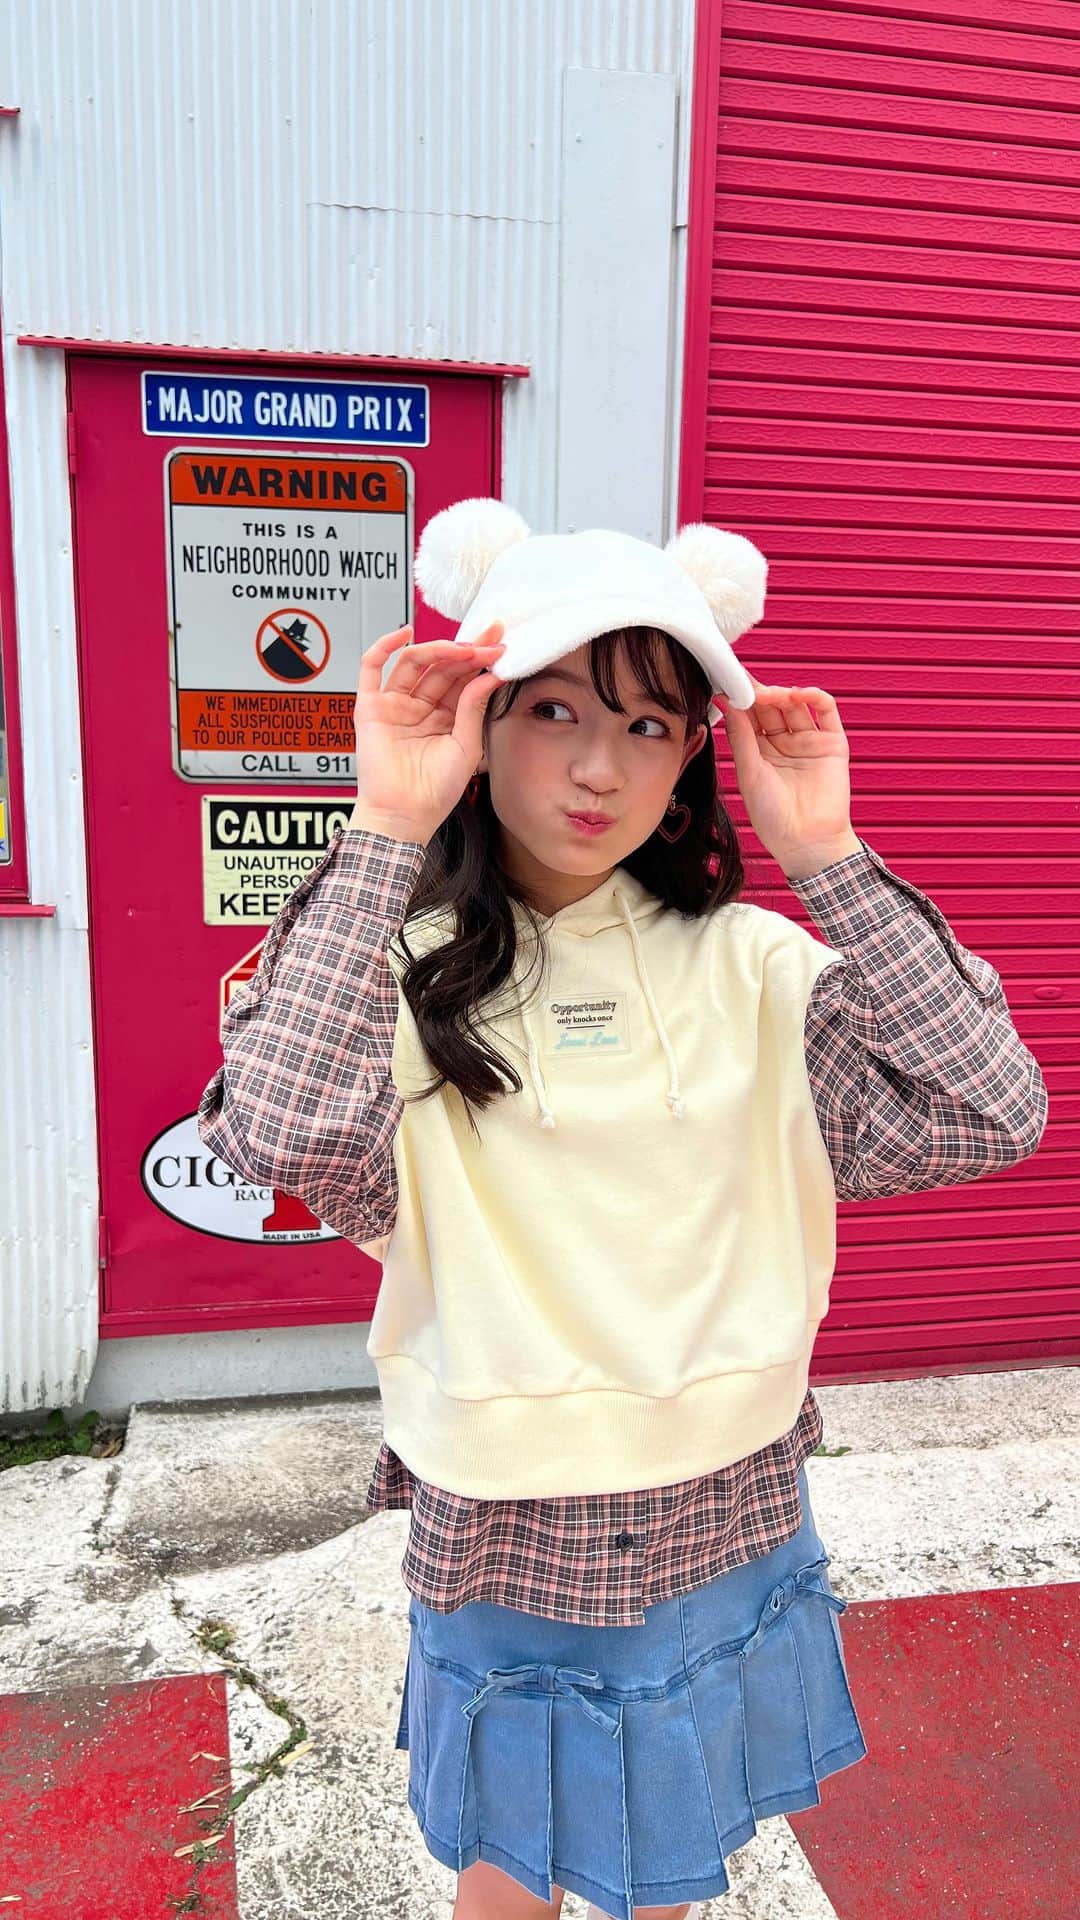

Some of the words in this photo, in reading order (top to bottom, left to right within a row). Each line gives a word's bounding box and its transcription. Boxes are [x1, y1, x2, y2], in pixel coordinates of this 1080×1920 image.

[158, 386, 243, 424] MAJOR
[254, 391, 337, 429] GRAND
[347, 395, 413, 432] PRIX
[191, 465, 387, 502] WARNING
[242, 522, 286, 538] THIS
[296, 525, 315, 538] IS
[325, 525, 338, 540] A
[182, 545, 330, 577] NEIGHBORHOOD
[339, 550, 398, 580] WATCH
[232, 584, 351, 602] COMMUNITY
[205, 696, 226, 712] WE
[233, 696, 322, 713] IMMEDIATELY
[197, 713, 224, 728] ALL
[230, 714, 313, 729] SUSPICIOUS
[193, 730, 210, 745] TO
[217, 731, 245, 746] OUR
[252, 732, 300, 747] POLICE
[241, 754, 301, 773] CALL
[316, 755, 350, 774] 911
[220, 893, 292, 916] KEE
[551, 1000, 617, 1014] Opportunity
[557, 1016, 572, 1025] only
[573, 1014, 597, 1023] knocks
[263, 1232, 288, 1241] MADE
[290, 1232, 301, 1240] IN
[302, 1231, 321, 1239] USA
